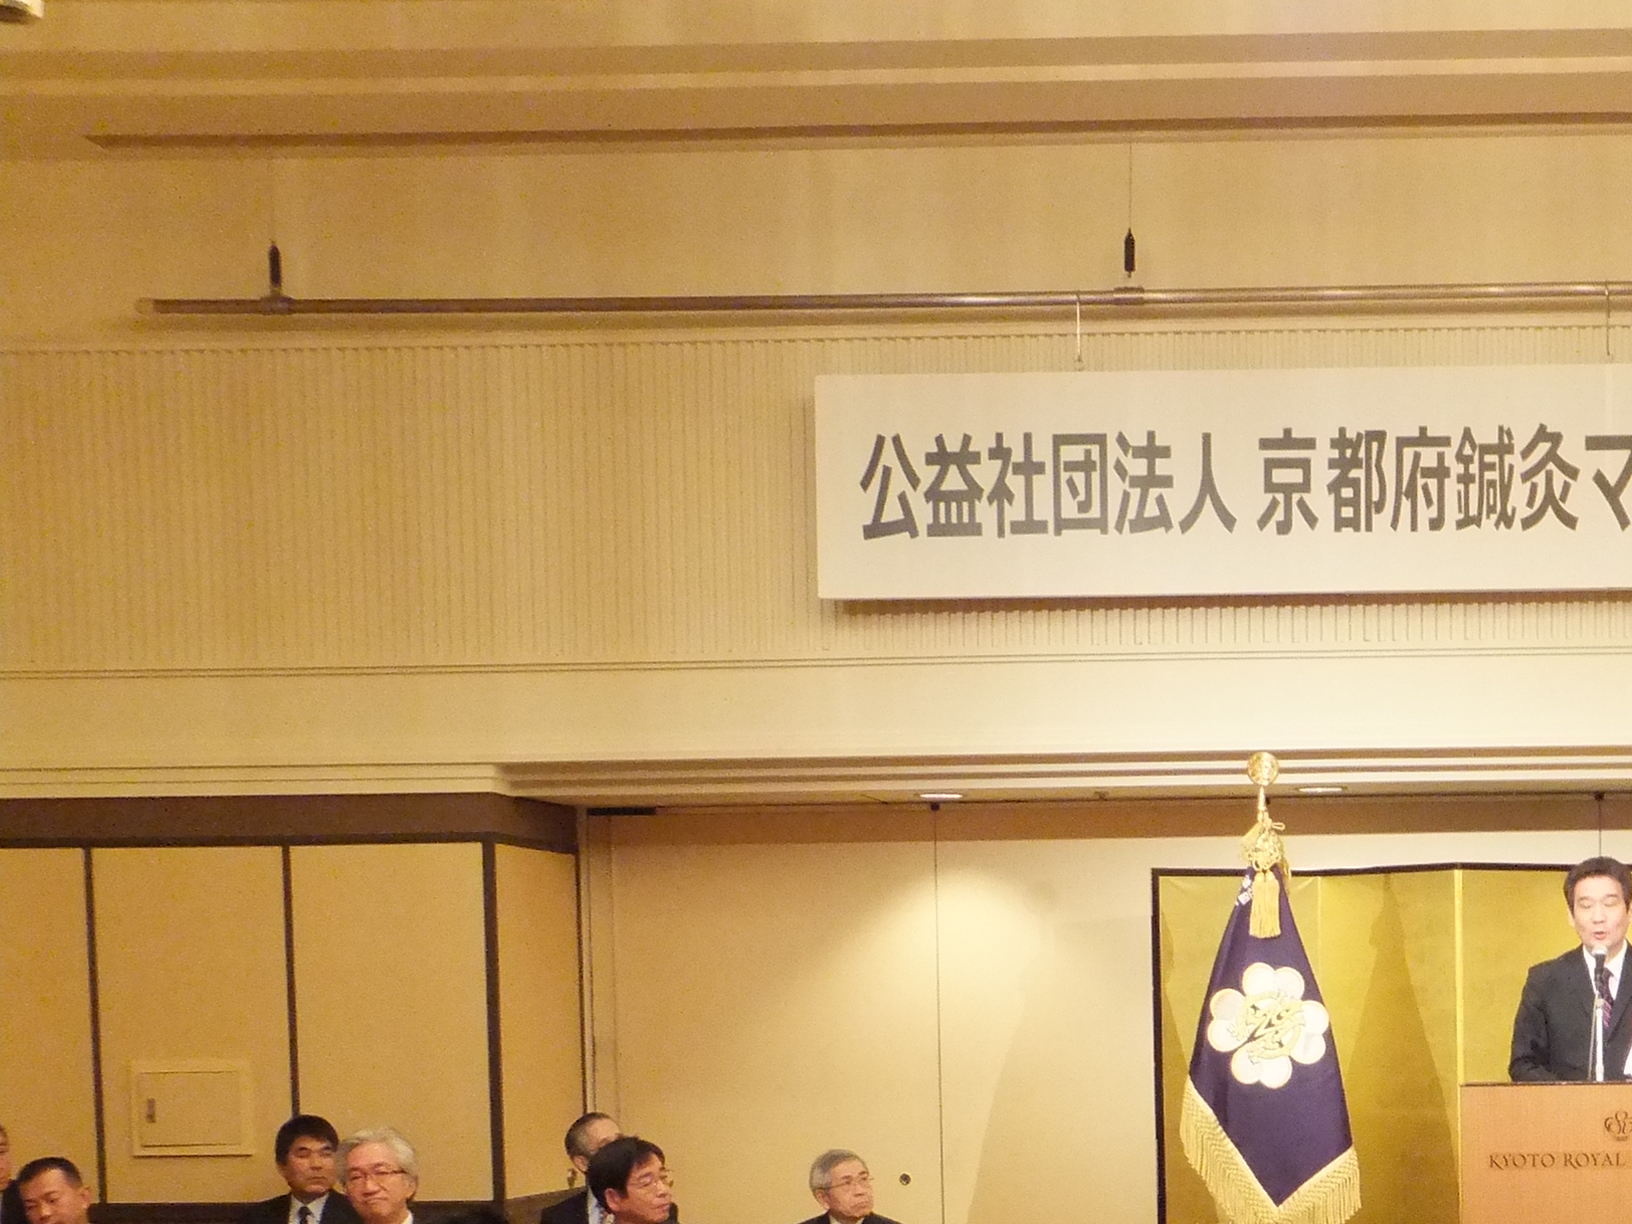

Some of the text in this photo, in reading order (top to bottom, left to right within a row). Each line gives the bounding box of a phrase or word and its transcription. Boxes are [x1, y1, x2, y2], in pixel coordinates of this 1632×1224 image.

[859, 429, 1238, 540] 公益社団法人
[1488, 1152, 1556, 1170] KYOTO
[1563, 1152, 1626, 1169] ROYAL
